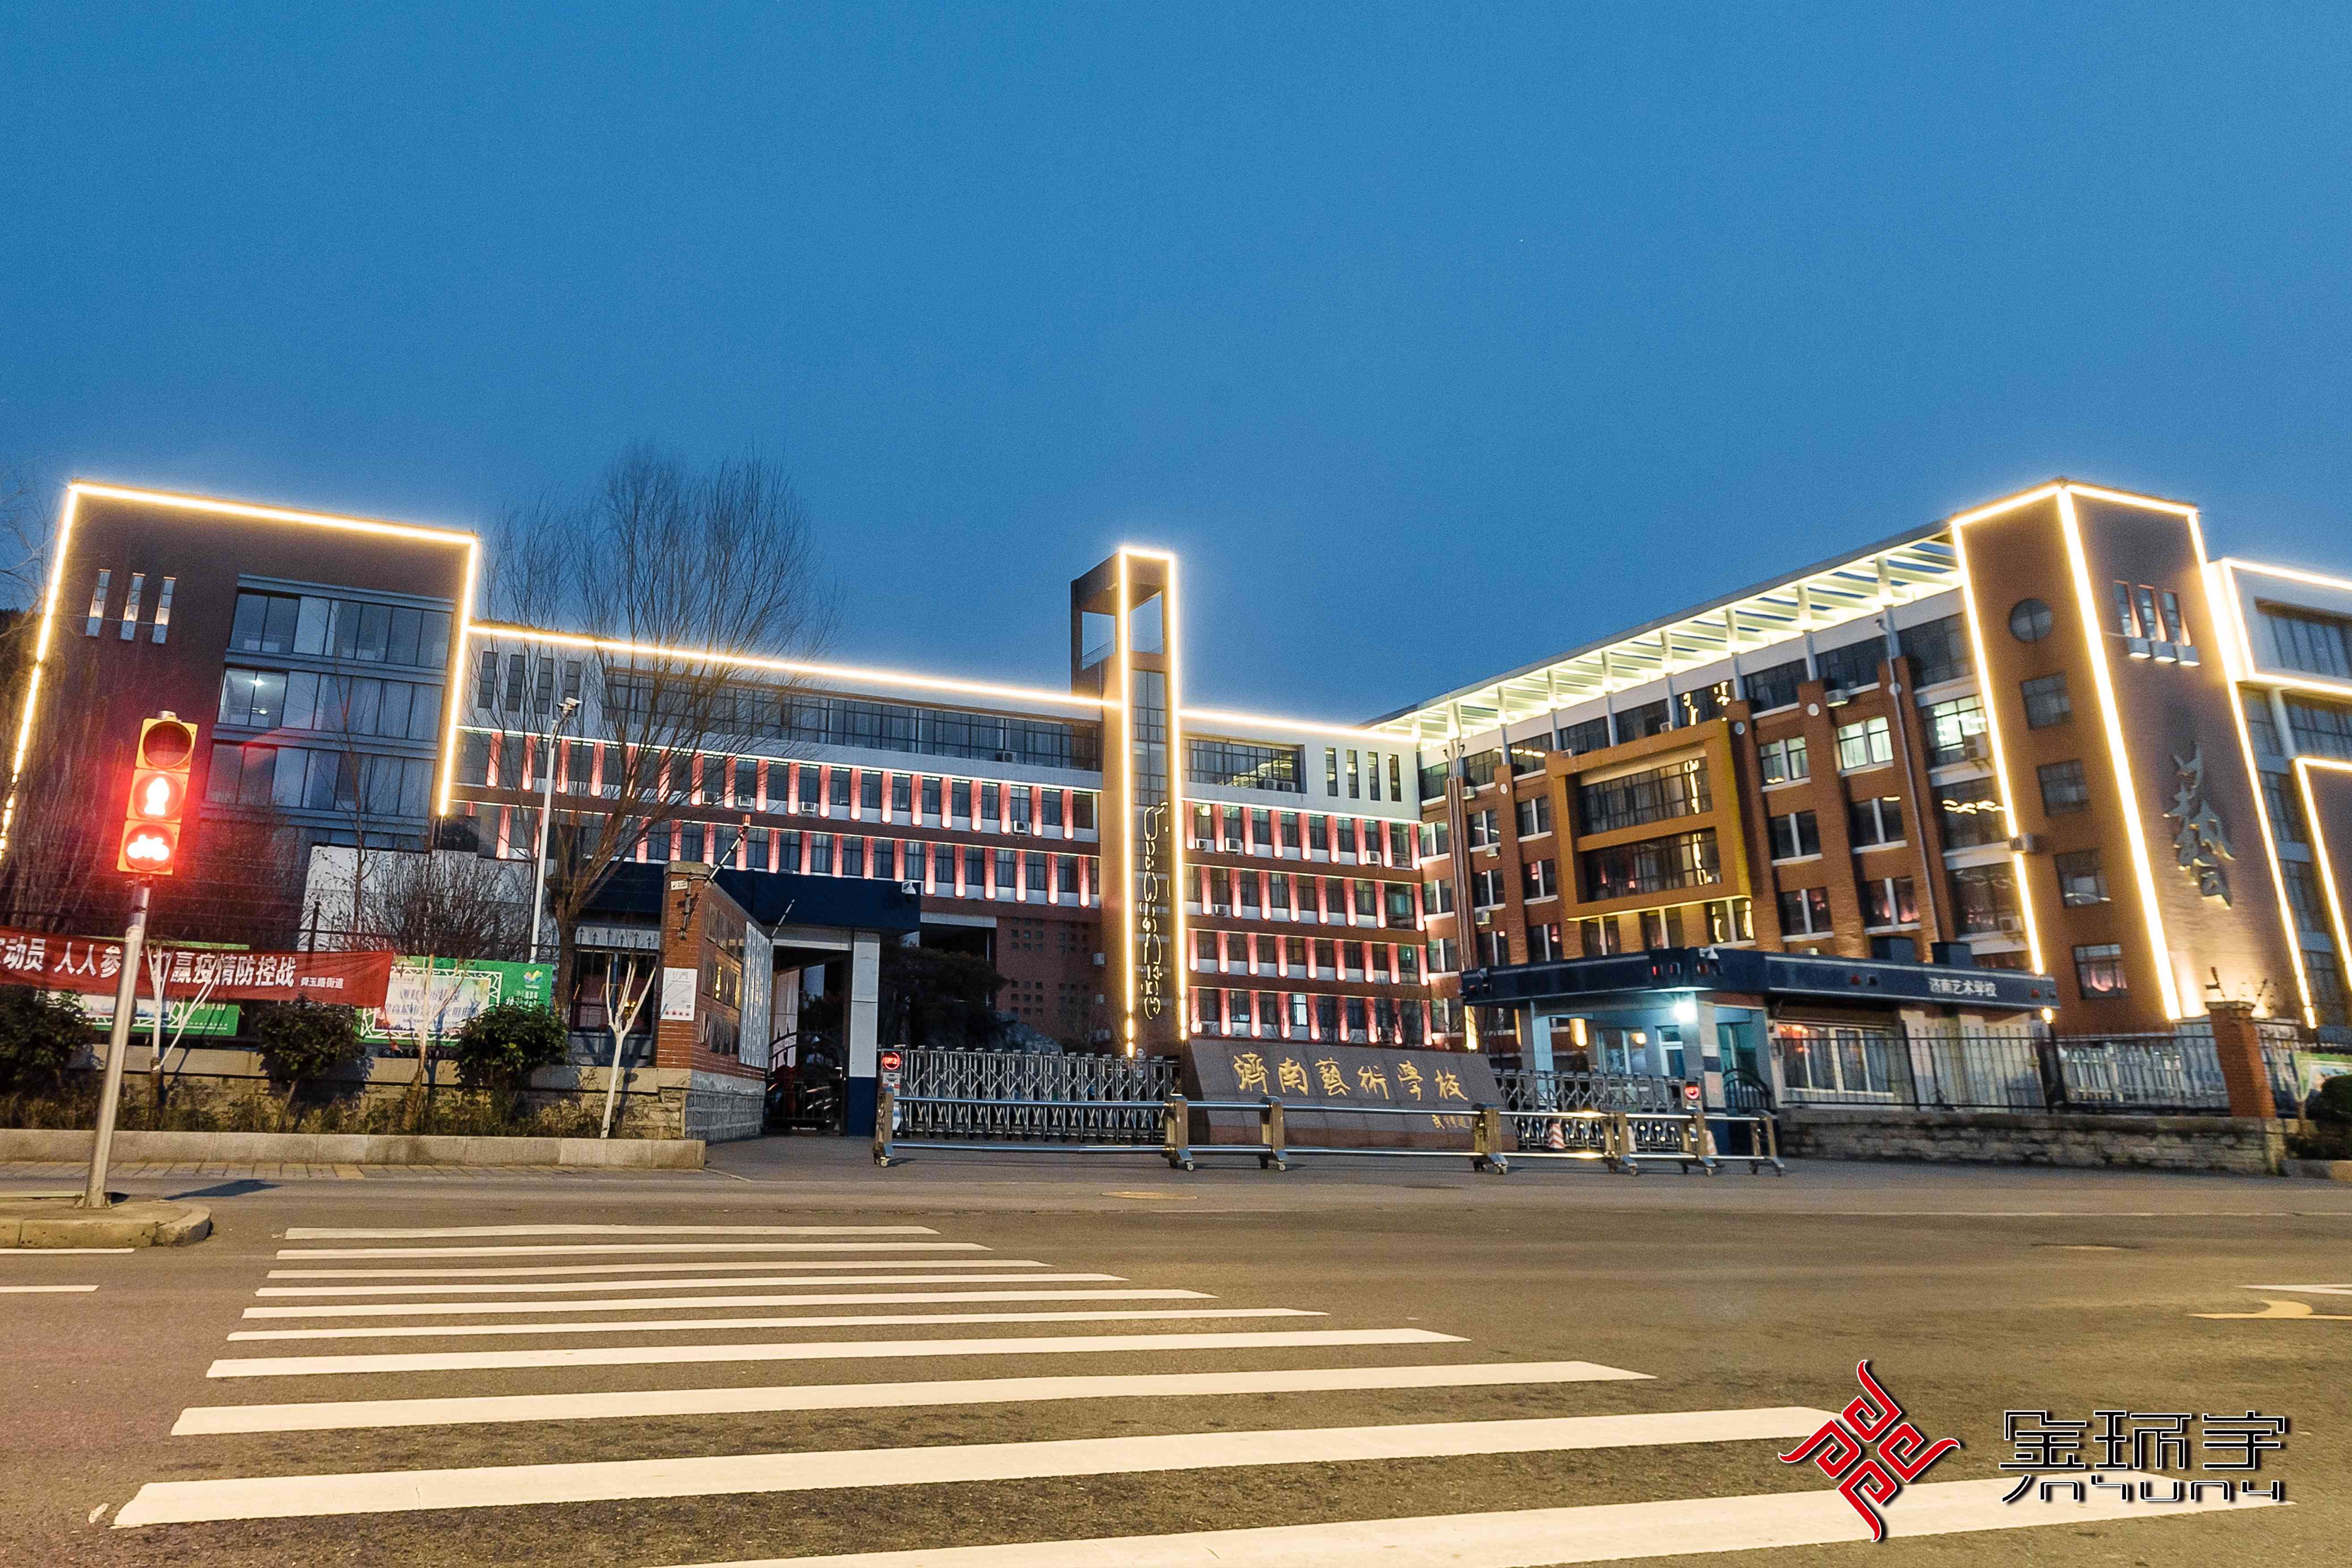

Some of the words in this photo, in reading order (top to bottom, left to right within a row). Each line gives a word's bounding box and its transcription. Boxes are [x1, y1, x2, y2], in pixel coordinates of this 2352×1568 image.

[0, 936, 46, 971] 动员
[54, 942, 143, 978] 人人参
